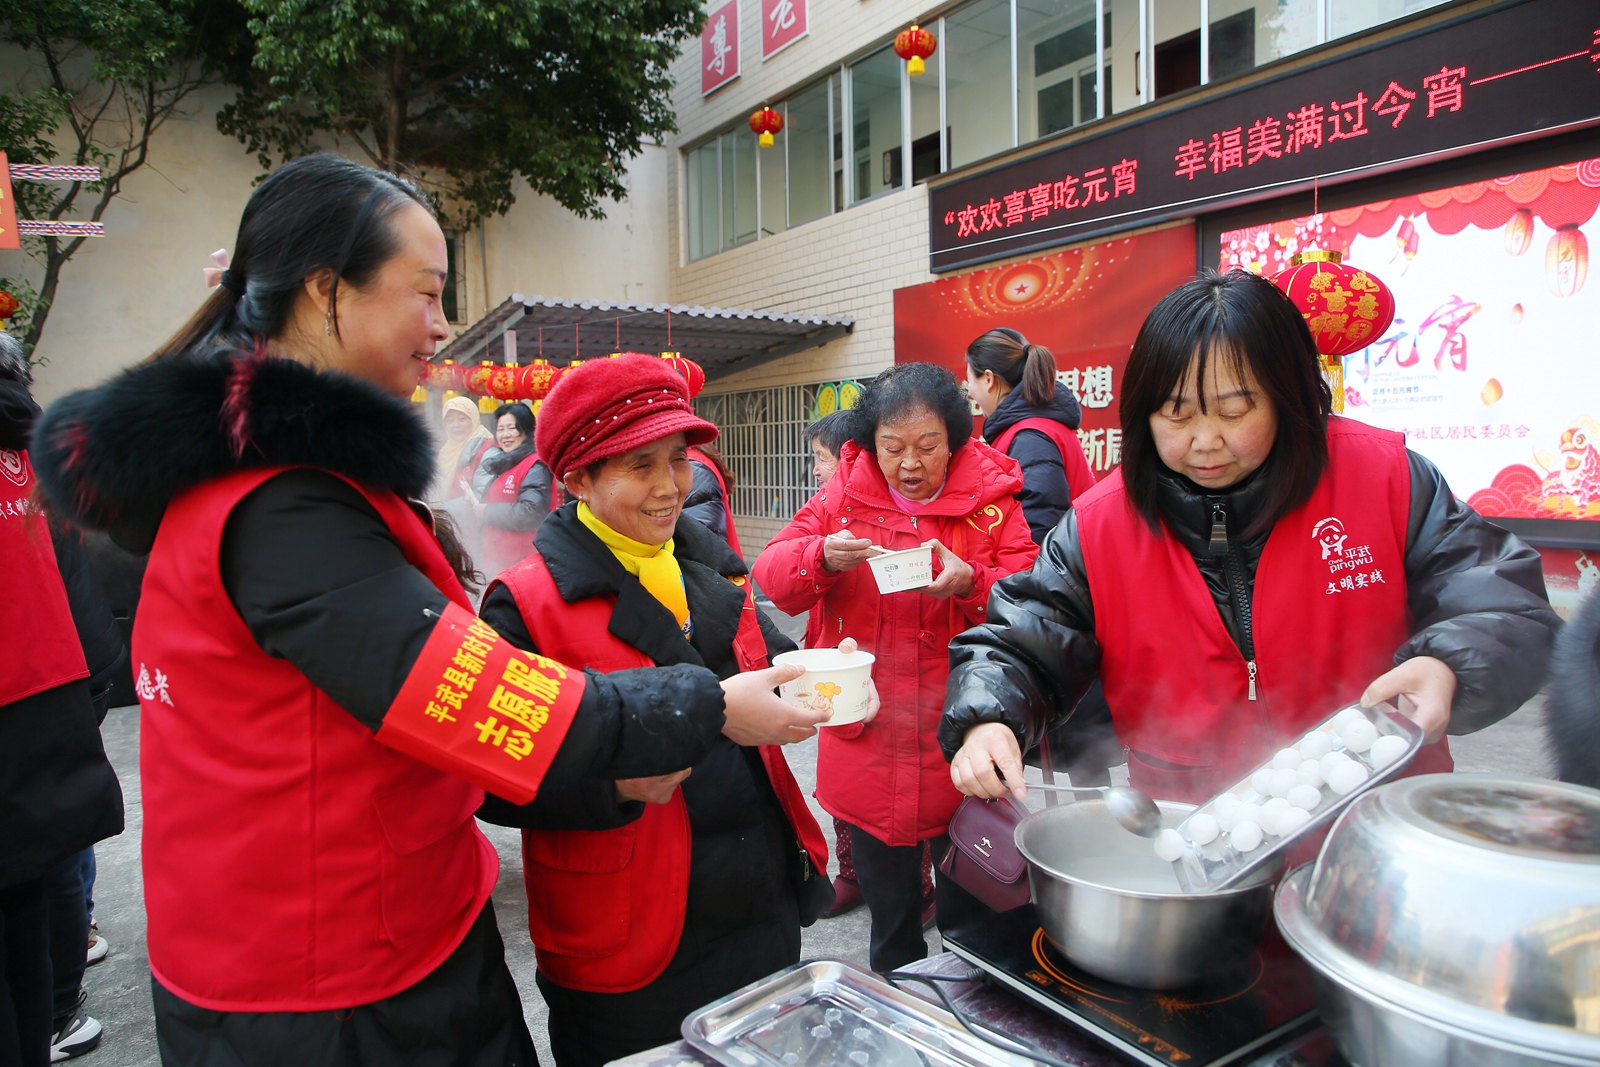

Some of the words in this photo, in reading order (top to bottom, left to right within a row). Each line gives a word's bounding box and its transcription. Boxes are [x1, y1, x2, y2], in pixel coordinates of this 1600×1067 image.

[1387, 424, 1531, 440] 寺社区居民委员会
[1344, 544, 1372, 559] 平武
[1325, 568, 1386, 595] 文明实践
